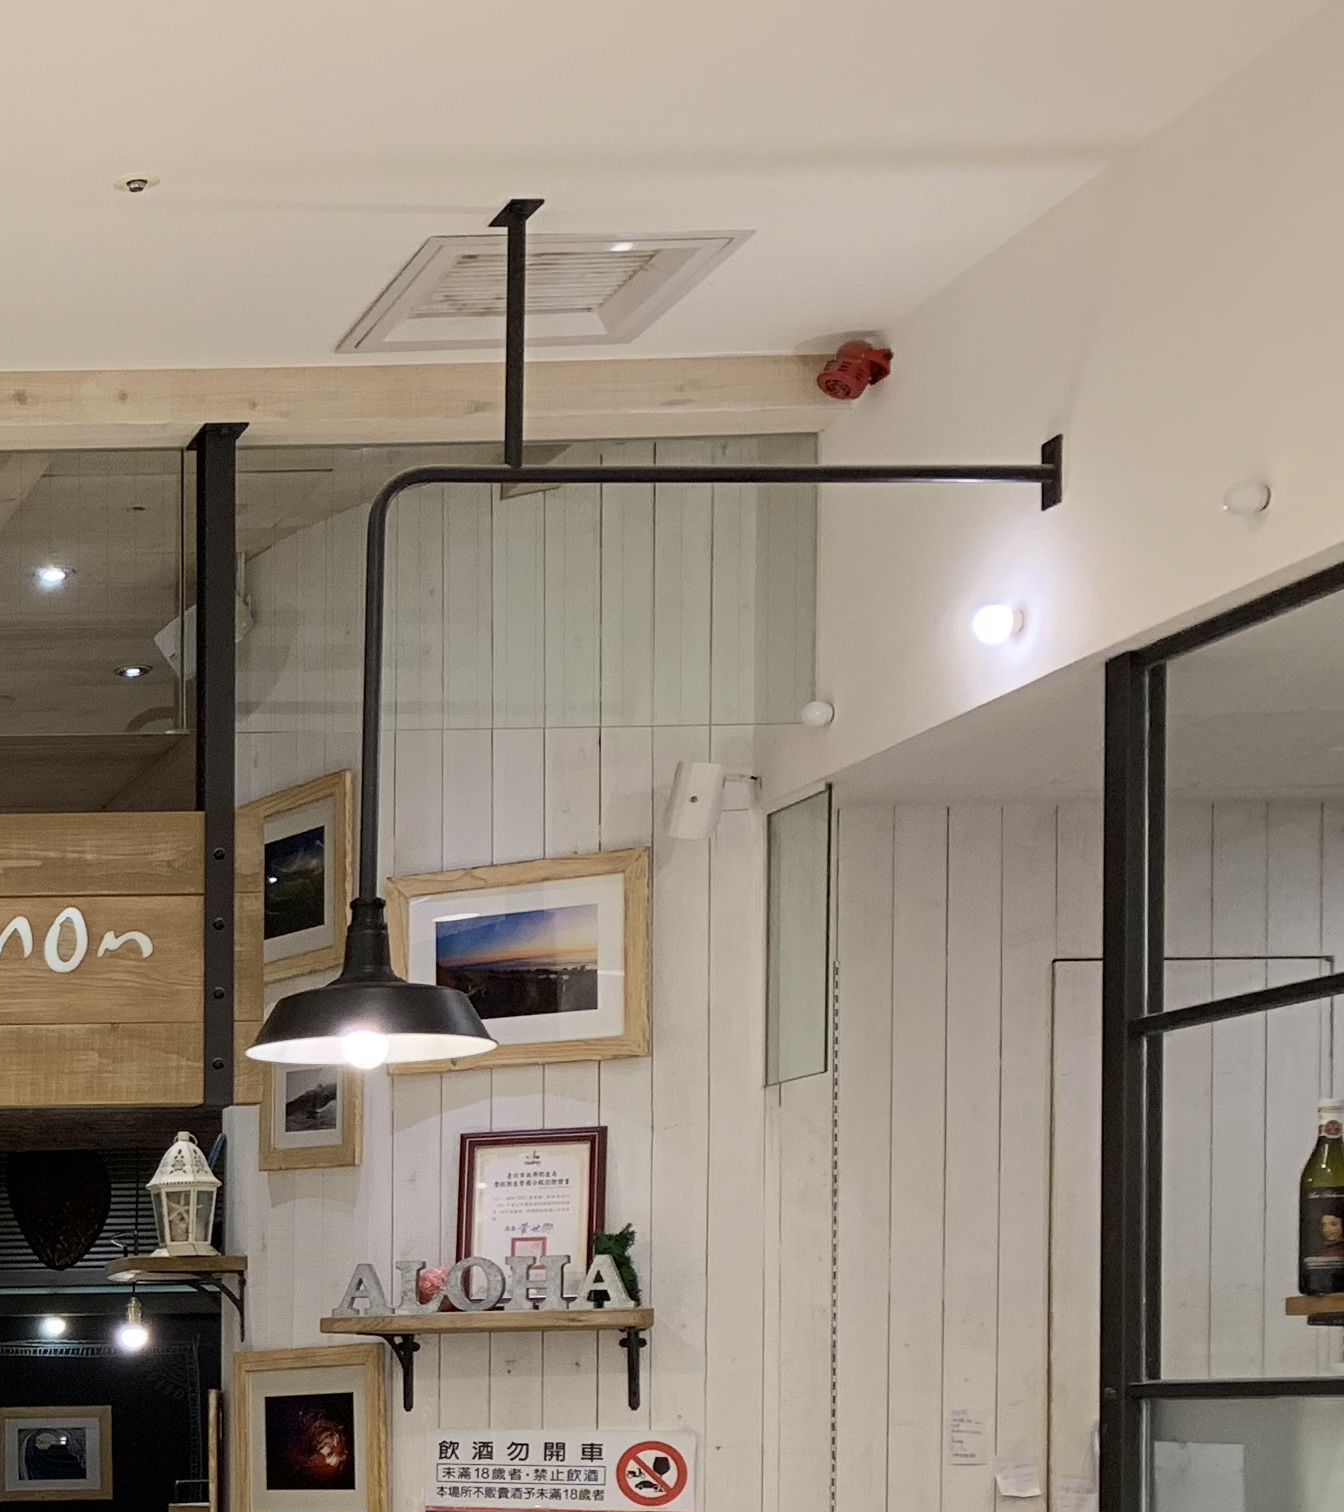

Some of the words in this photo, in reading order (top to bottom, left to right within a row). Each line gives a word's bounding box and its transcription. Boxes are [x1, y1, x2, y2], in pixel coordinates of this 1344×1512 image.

[331, 1253, 635, 1316] ALOHA
[438, 1440, 604, 1462] 飲酒勿開車
